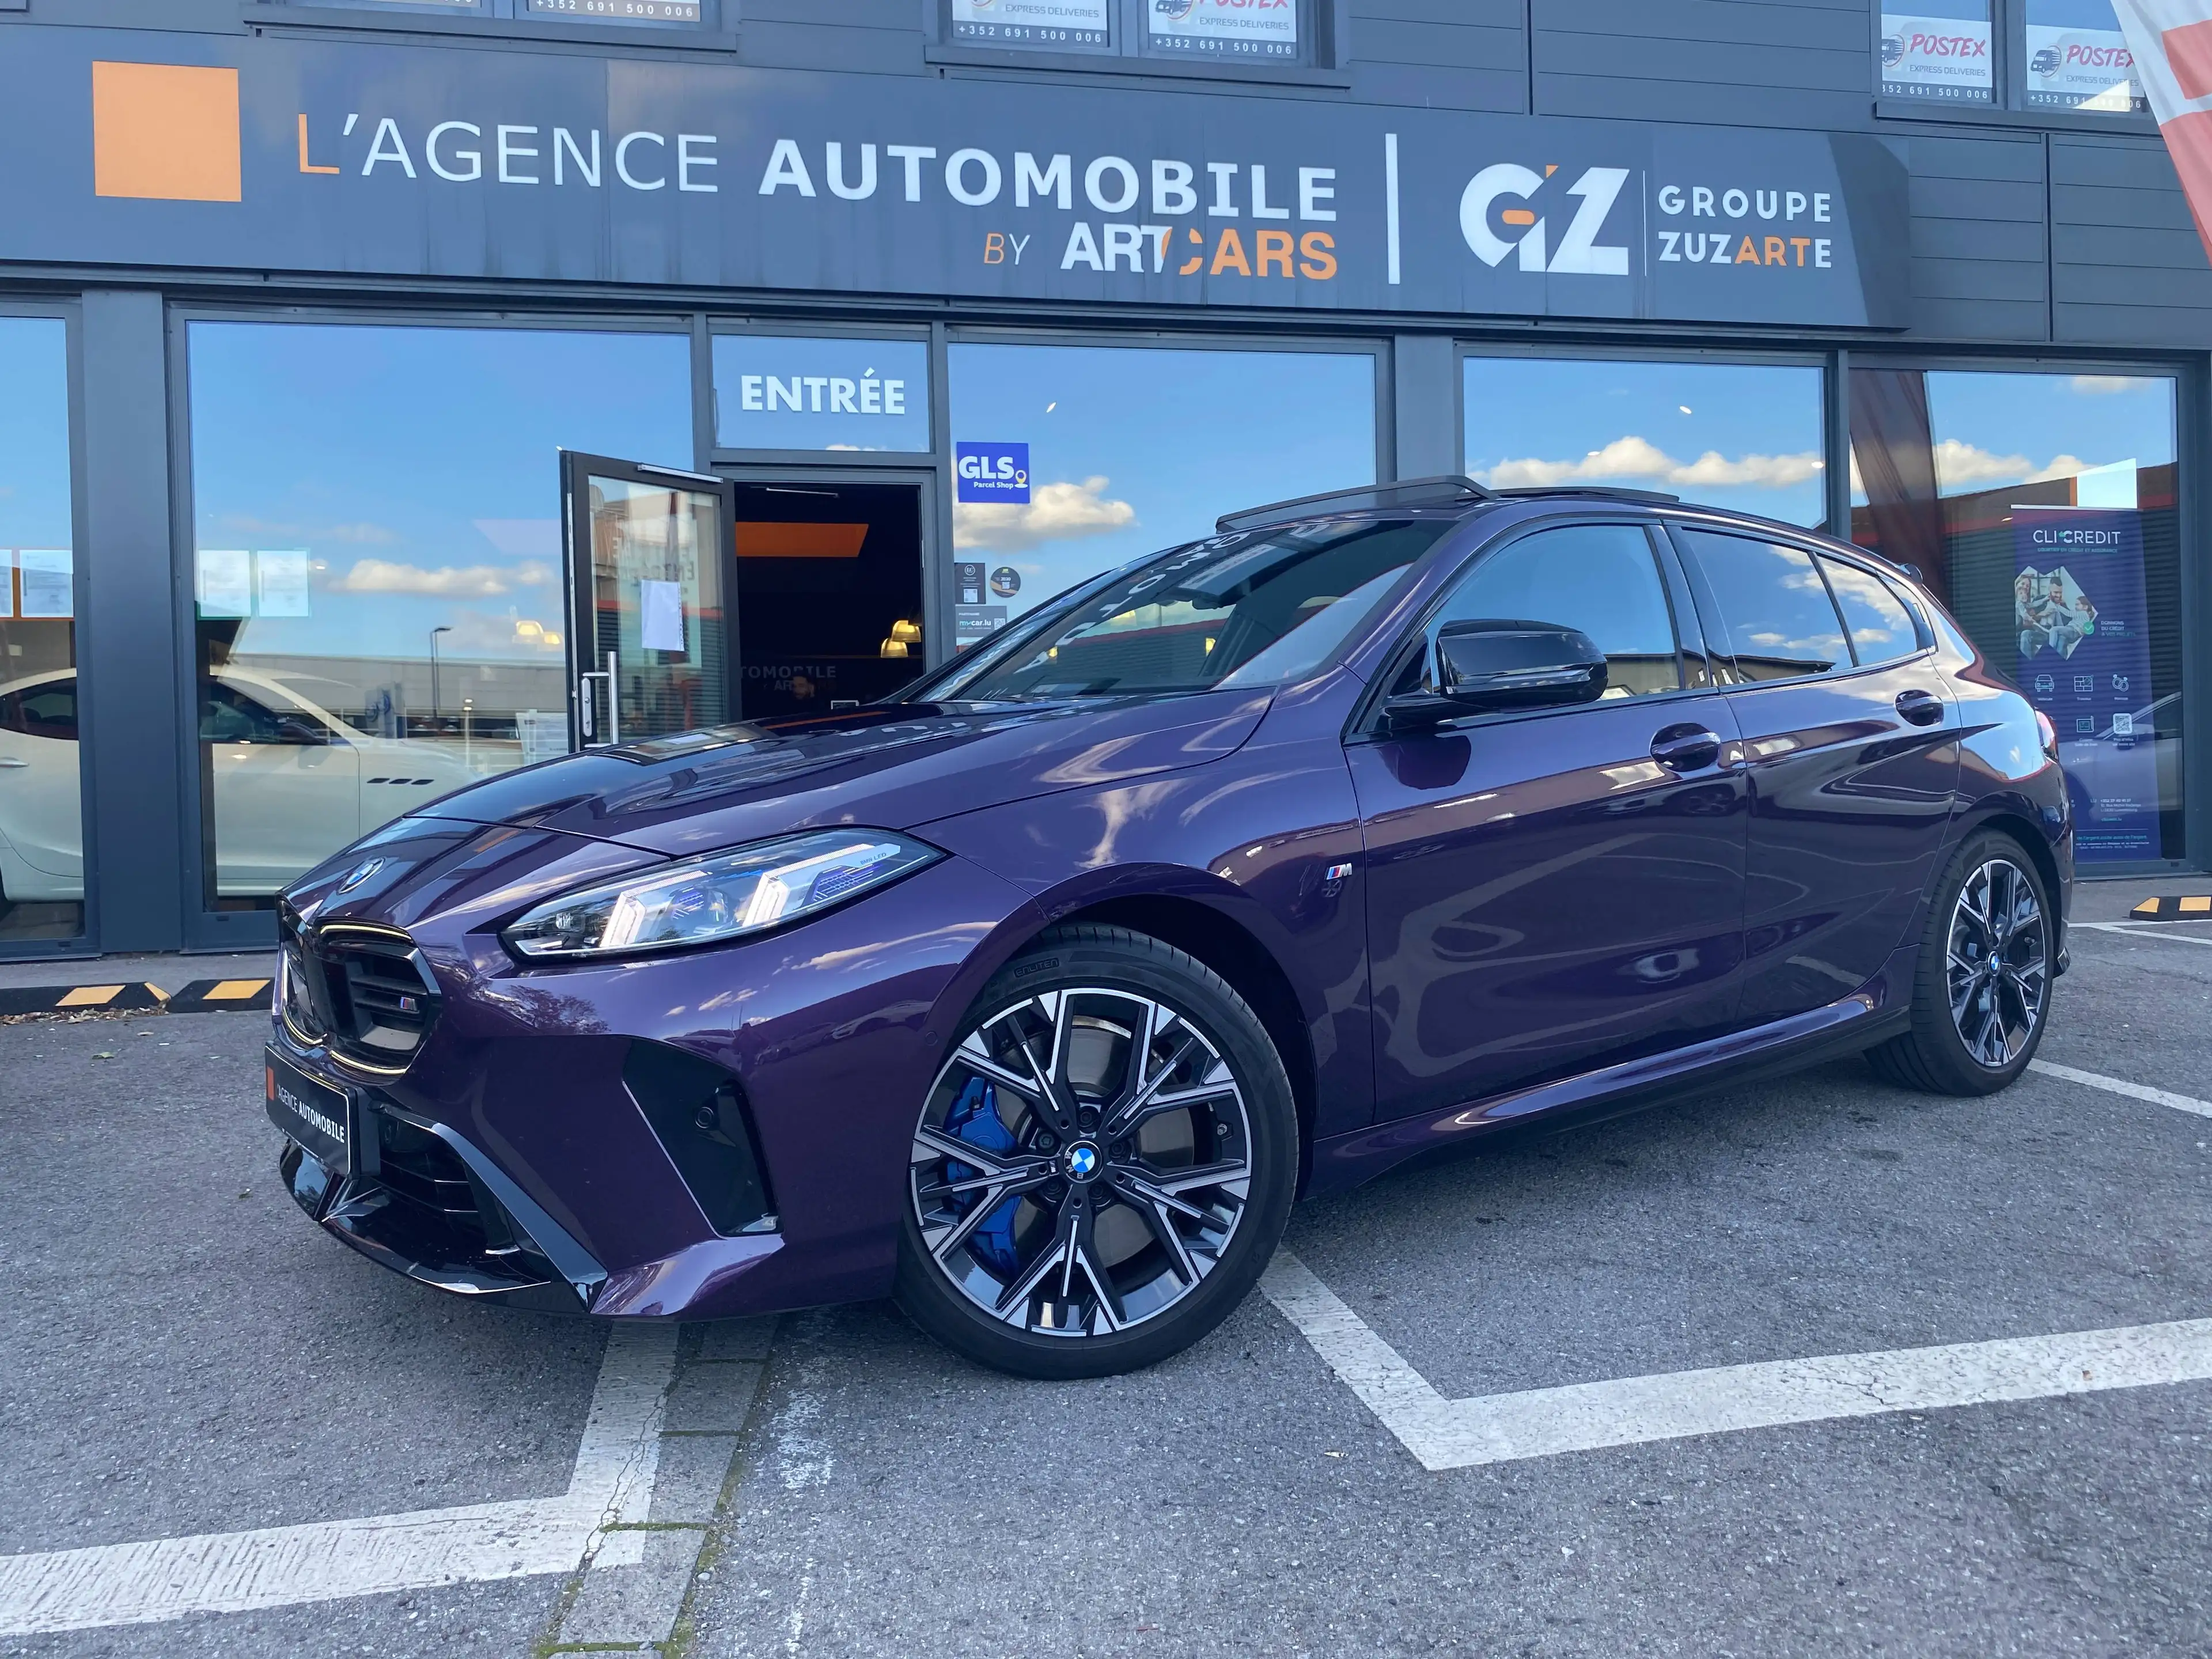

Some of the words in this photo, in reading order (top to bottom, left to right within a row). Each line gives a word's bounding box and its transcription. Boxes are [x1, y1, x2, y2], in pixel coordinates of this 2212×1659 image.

[587, 1, 615, 12] 691
[626, 3, 654, 15] 500
[665, 6, 692, 17] 006
[1005, 4, 1046, 14] EXPRESS
[1048, 7, 1099, 18] DELIVERIES
[1199, 17, 1238, 27] EXPRESS
[1240, 20, 1289, 30] DELIVERIES
[959, 25, 995, 36] +352
[1005, 27, 1030, 39] 691
[1040, 30, 1066, 41] 500
[1075, 32, 1101, 43] 006
[1156, 38, 1190, 48] +352
[1199, 40, 1224, 50] 691
[1234, 43, 1258, 52] 500
[1267, 44, 1291, 55] 006
[1910, 33, 1986, 57] POSTEX
[1910, 65, 1942, 74] EXPRESS
[1944, 67, 1986, 76] DELIVERIES
[2066, 75, 2097, 84] EXPRESS
[1910, 86, 1930, 95] 691
[1938, 88, 1959, 97] 500
[1967, 90, 1987, 99] 006
[2031, 94, 2059, 103] +352
[2066, 96, 2085, 104] 691
[298, 113, 718, 193] L'AGENCE
[758, 139, 1337, 222] AUTOMOBILE
[1658, 185, 1831, 223] GROUPE
[983, 232, 1031, 266] BY
[1060, 221, 1338, 281] ARTCARS
[1658, 232, 1832, 269] ZUZARTE
[741, 366, 906, 415] ENTRÉE
[2033, 530, 2121, 544] CLICREDIT
[874, 852, 887, 860] LED
[276, 1083, 298, 1113] 'AGENCE
[298, 1101, 345, 1143] AUTOMOBILE
